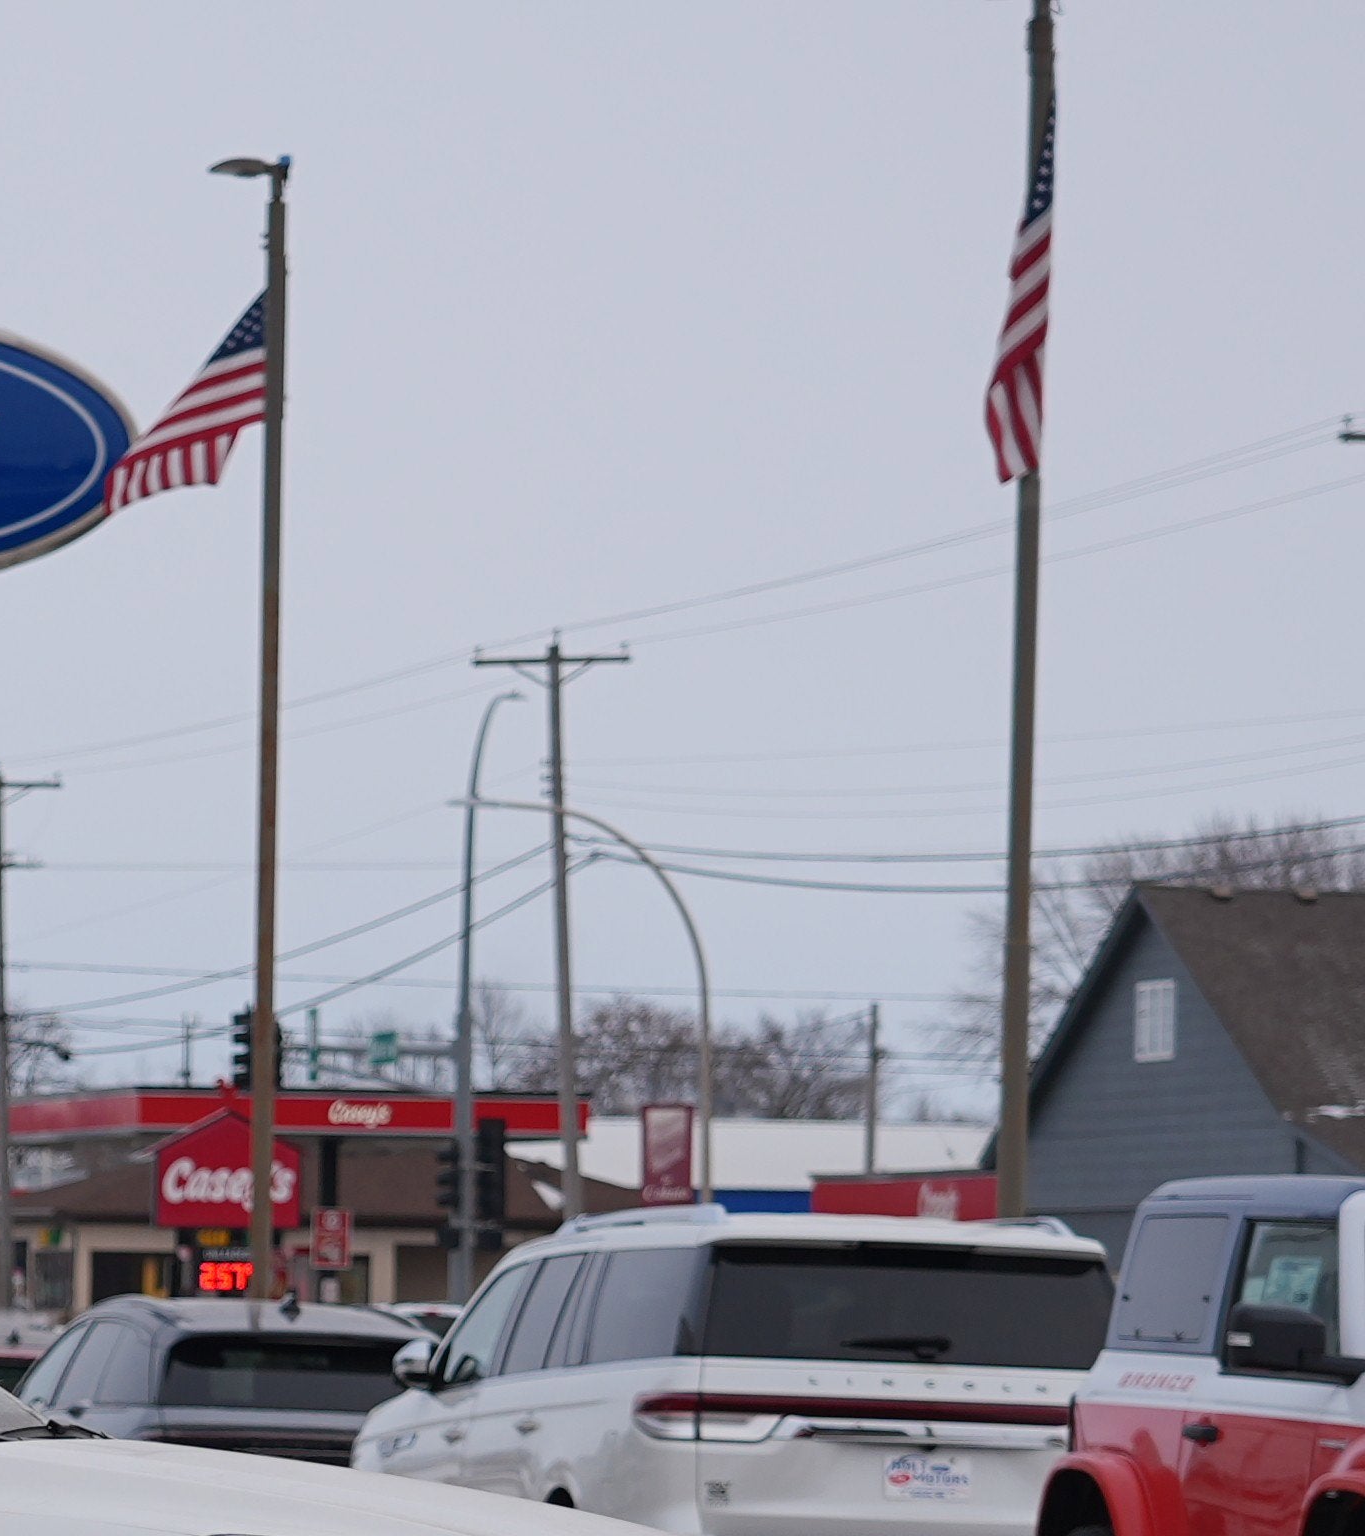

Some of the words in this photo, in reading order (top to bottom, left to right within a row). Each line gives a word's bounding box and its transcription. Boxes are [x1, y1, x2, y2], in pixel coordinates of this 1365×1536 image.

[327, 1099, 392, 1129] Casey's
[162, 1156, 296, 1213] Case's
[807, 1375, 1048, 1394] LINCOLN
